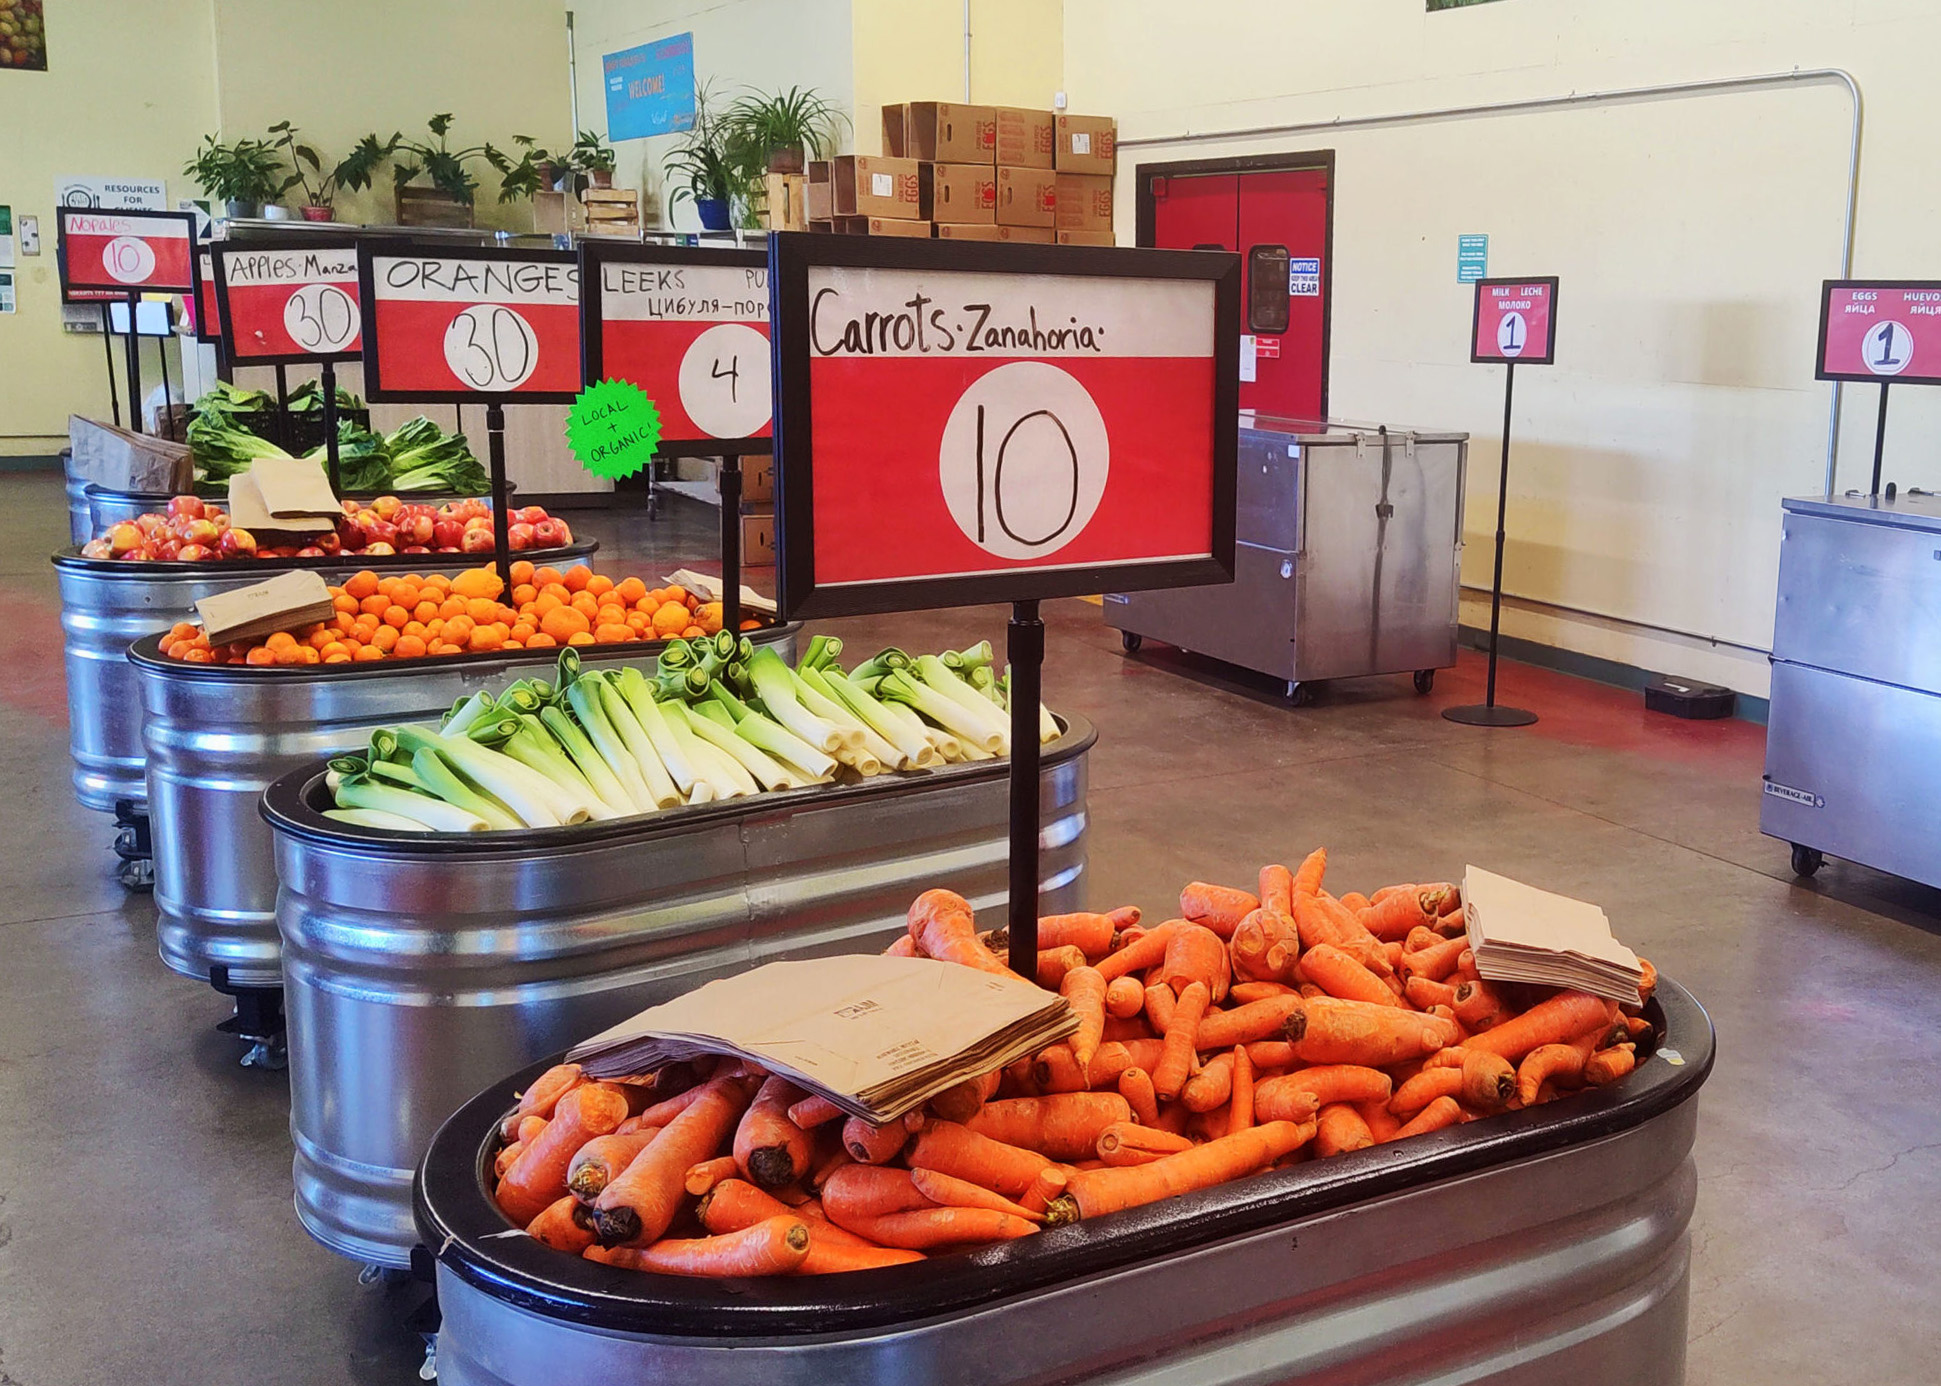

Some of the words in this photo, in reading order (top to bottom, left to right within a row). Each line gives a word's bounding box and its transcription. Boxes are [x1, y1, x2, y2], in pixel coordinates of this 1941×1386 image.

[104, 184, 160, 194] RESOURCES
[123, 196, 143, 204] FOR
[905, 174, 918, 204] EGGS
[111, 242, 140, 273] 10
[1291, 262, 1317, 272] NOTICE
[603, 267, 685, 294] LEEKS
[1291, 283, 1317, 293] CLEAR
[1492, 288, 1510, 296] MILK
[1520, 287, 1543, 296] LECHE
[1498, 300, 1531, 309] МОЛОКО
[1844, 302, 1875, 315] ЯЙЦА
[1852, 291, 1878, 301] EGGS
[290, 288, 351, 347] 30
[1503, 315, 1521, 349] 1
[1874, 322, 1900, 365] 1
[452, 308, 529, 387] 30
[711, 355, 739, 403] 4
[581, 400, 629, 426] LOCAL
[590, 422, 652, 462] ORGANIC!
[977, 404, 1078, 546] 10
